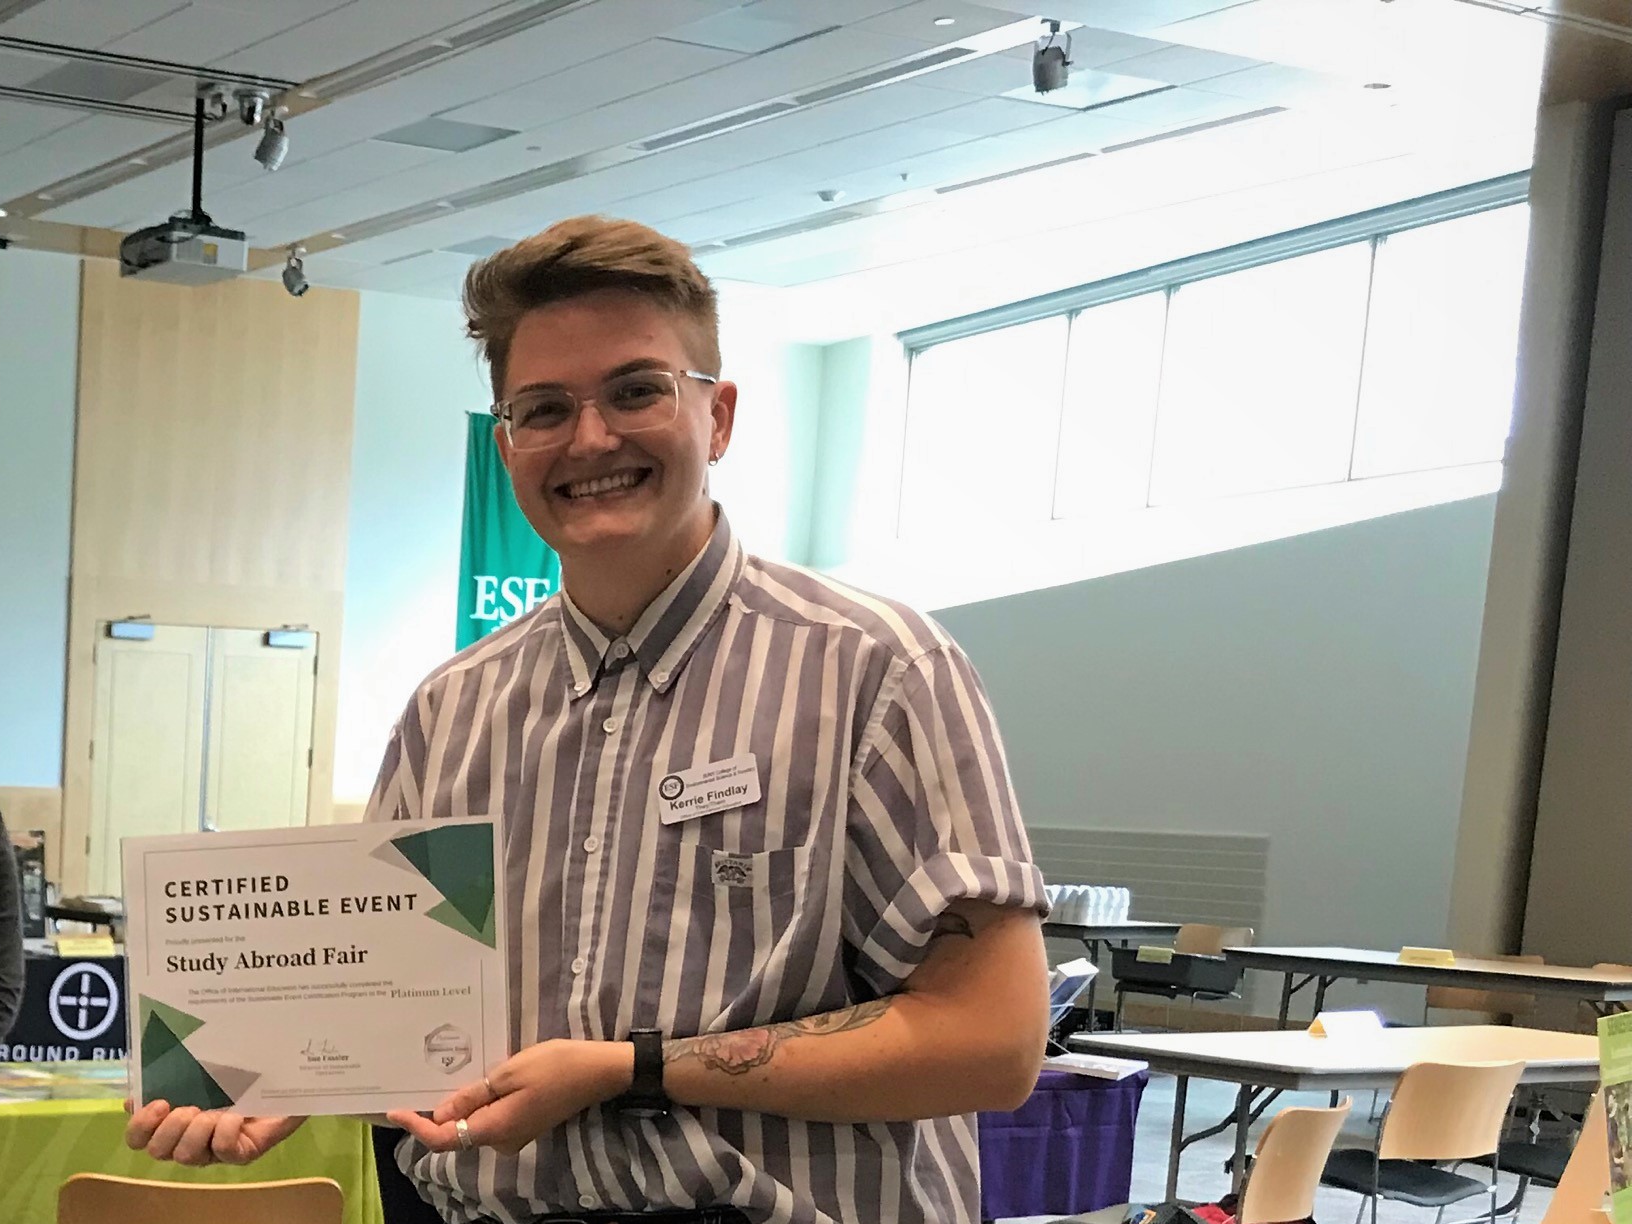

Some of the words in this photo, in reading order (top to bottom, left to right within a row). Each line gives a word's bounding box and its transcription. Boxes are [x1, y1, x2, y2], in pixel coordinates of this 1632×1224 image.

[469, 575, 550, 622] ESF
[670, 795, 704, 810] Kerrie
[707, 784, 748, 801] Findlay
[164, 875, 290, 898] CERTIFIED
[165, 899, 330, 924] SUSTAINABLE
[340, 893, 418, 914] EVENT
[166, 952, 229, 975] Study
[234, 948, 317, 970] Abroad
[322, 945, 368, 965] Fair
[391, 988, 439, 998] Platinum
[442, 986, 471, 996] Level
